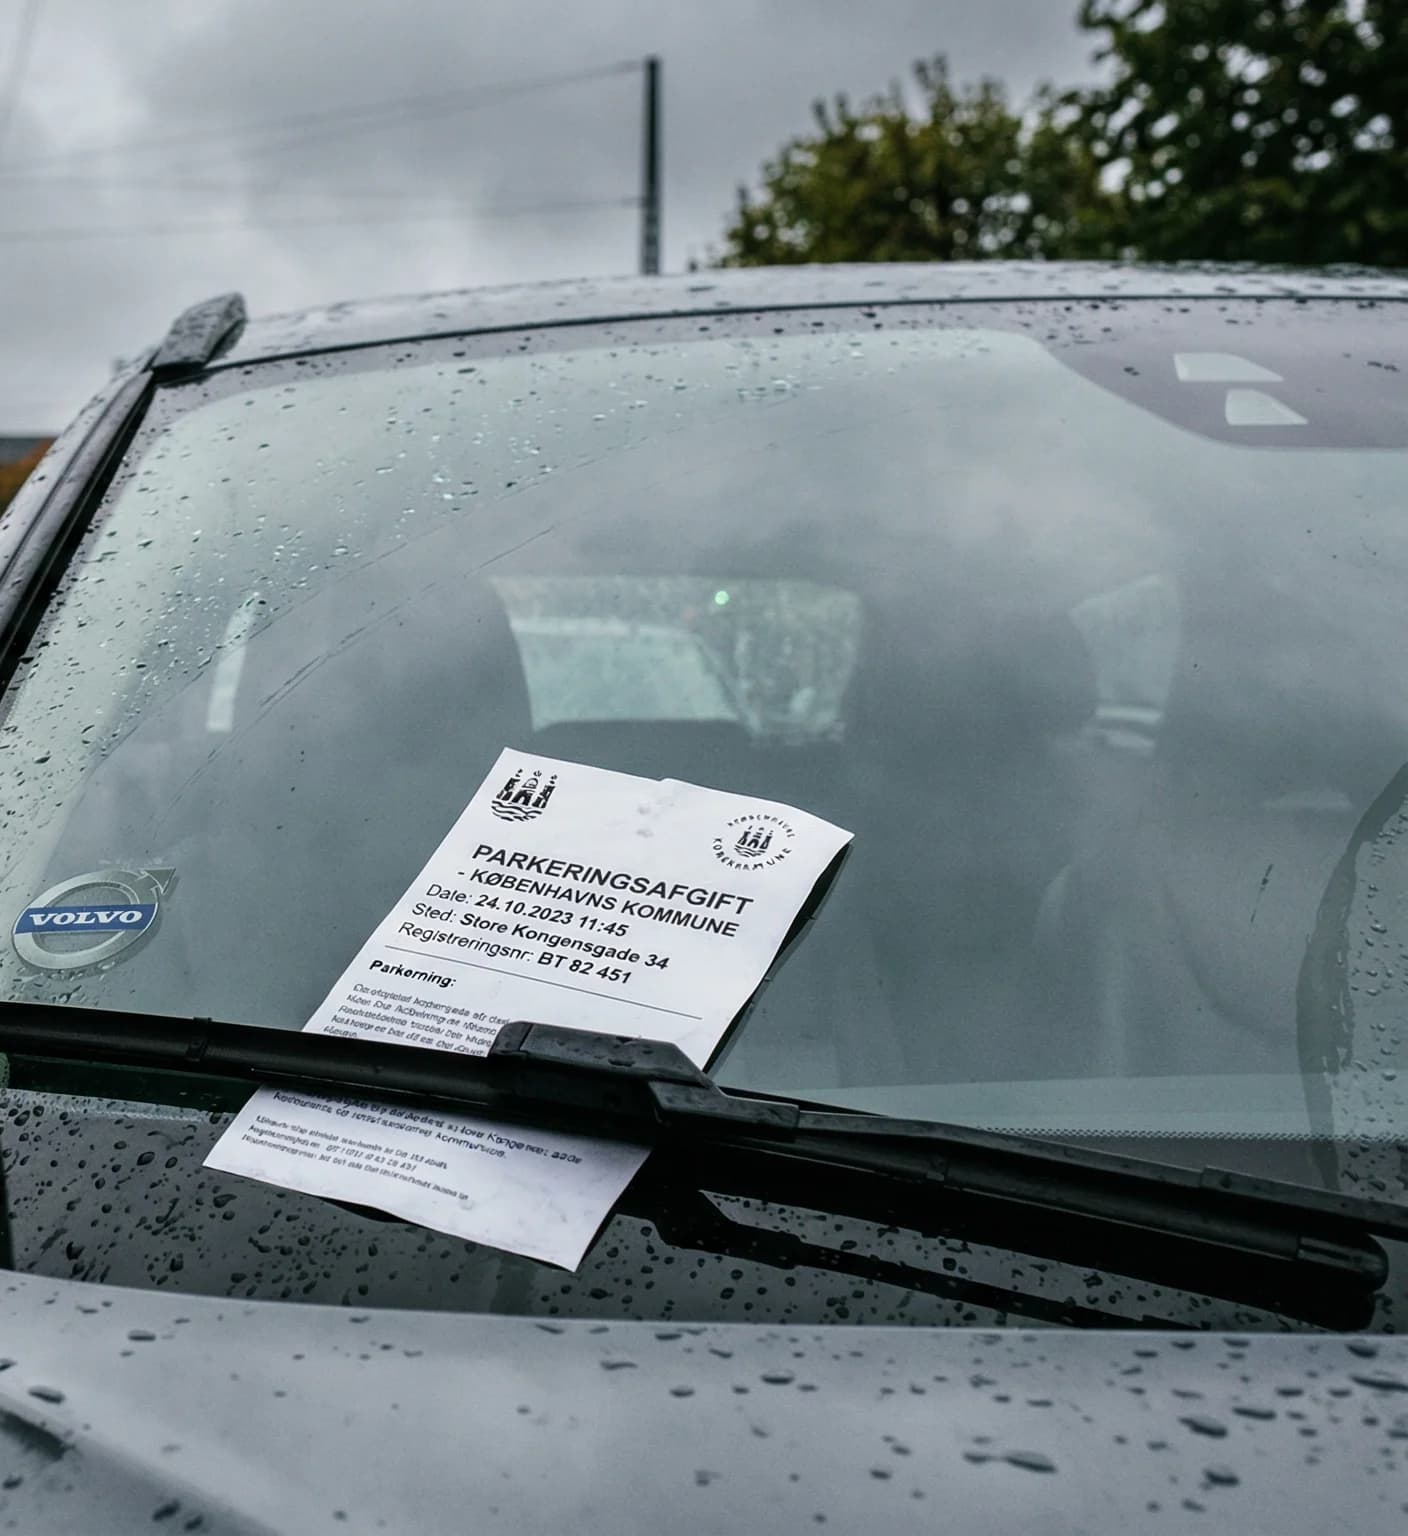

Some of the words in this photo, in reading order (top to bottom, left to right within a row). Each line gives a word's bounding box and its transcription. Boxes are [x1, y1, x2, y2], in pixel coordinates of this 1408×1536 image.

[469, 868, 617, 910] KØBENHAVNS
[620, 900, 740, 937] KOMMUNE
[472, 844, 754, 915] PARKERINGSAFGIFT
[29, 910, 143, 926] VOLVO
[474, 894, 574, 925] 24.10.2023
[579, 915, 629, 937] 11:45
[459, 912, 508, 934] Store
[644, 953, 670, 970] 34
[537, 951, 569, 968] BT
[569, 959, 594, 975] 82
[596, 966, 632, 984] 451
